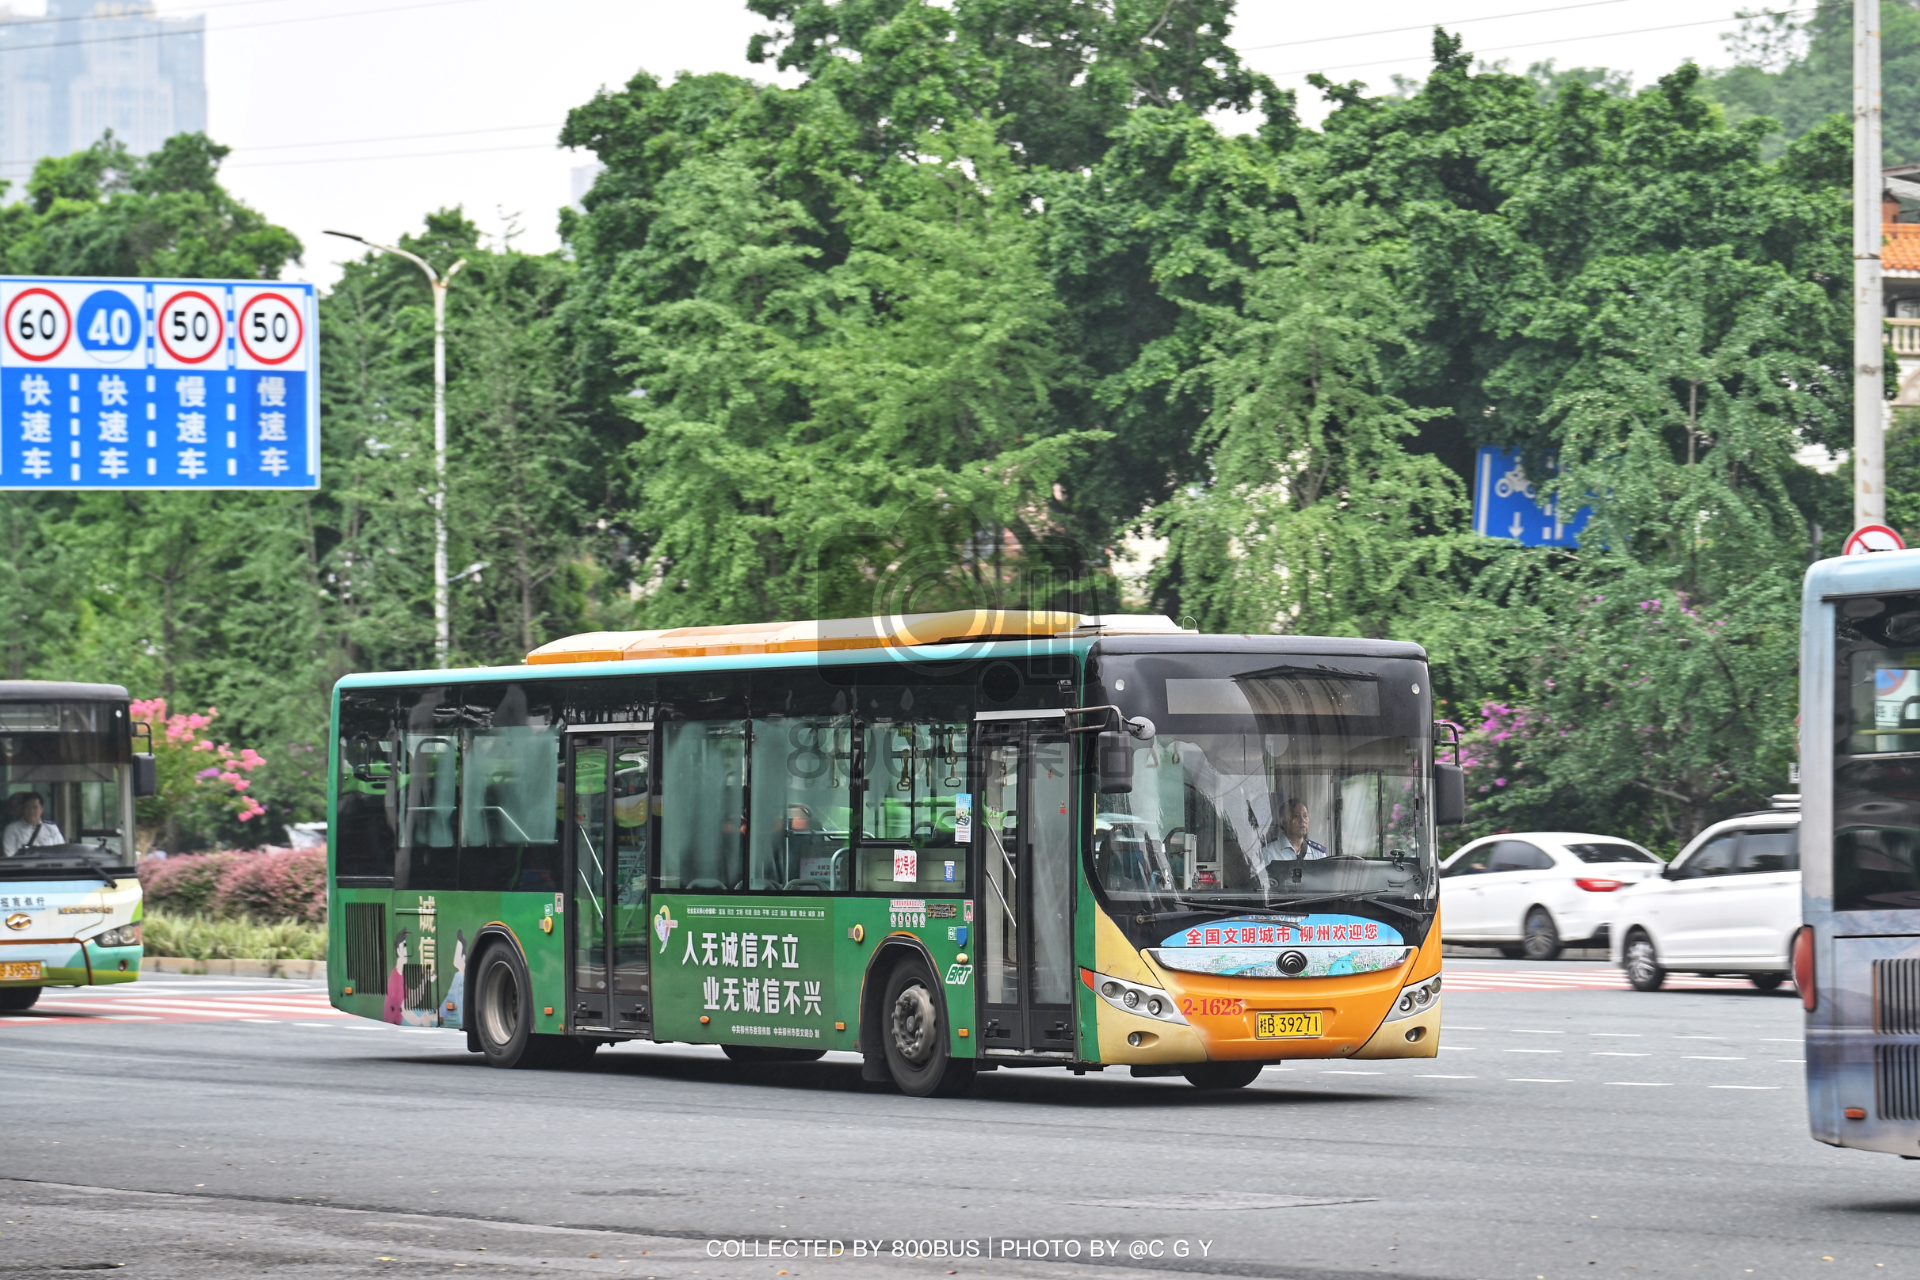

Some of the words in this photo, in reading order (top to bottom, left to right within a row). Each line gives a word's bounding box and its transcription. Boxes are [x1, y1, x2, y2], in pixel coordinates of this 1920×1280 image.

[20, 309, 56, 340] 60
[87, 308, 132, 346] 40
[172, 311, 209, 341] 50
[253, 312, 288, 342] 50
[21, 373, 52, 479] 快速车
[98, 374, 129, 479] 快速车
[176, 376, 207, 479] 慢速车
[257, 376, 289, 478] 慢速车
[682, 930, 800, 969] 人无诚信不立
[1186, 924, 1290, 946] 全国文明城市
[1299, 922, 1379, 943] 柳州欢迎您
[946, 964, 973, 985] BRT
[703, 975, 822, 1017] 业无诚信不兴
[1183, 998, 1244, 1016] 2-1625
